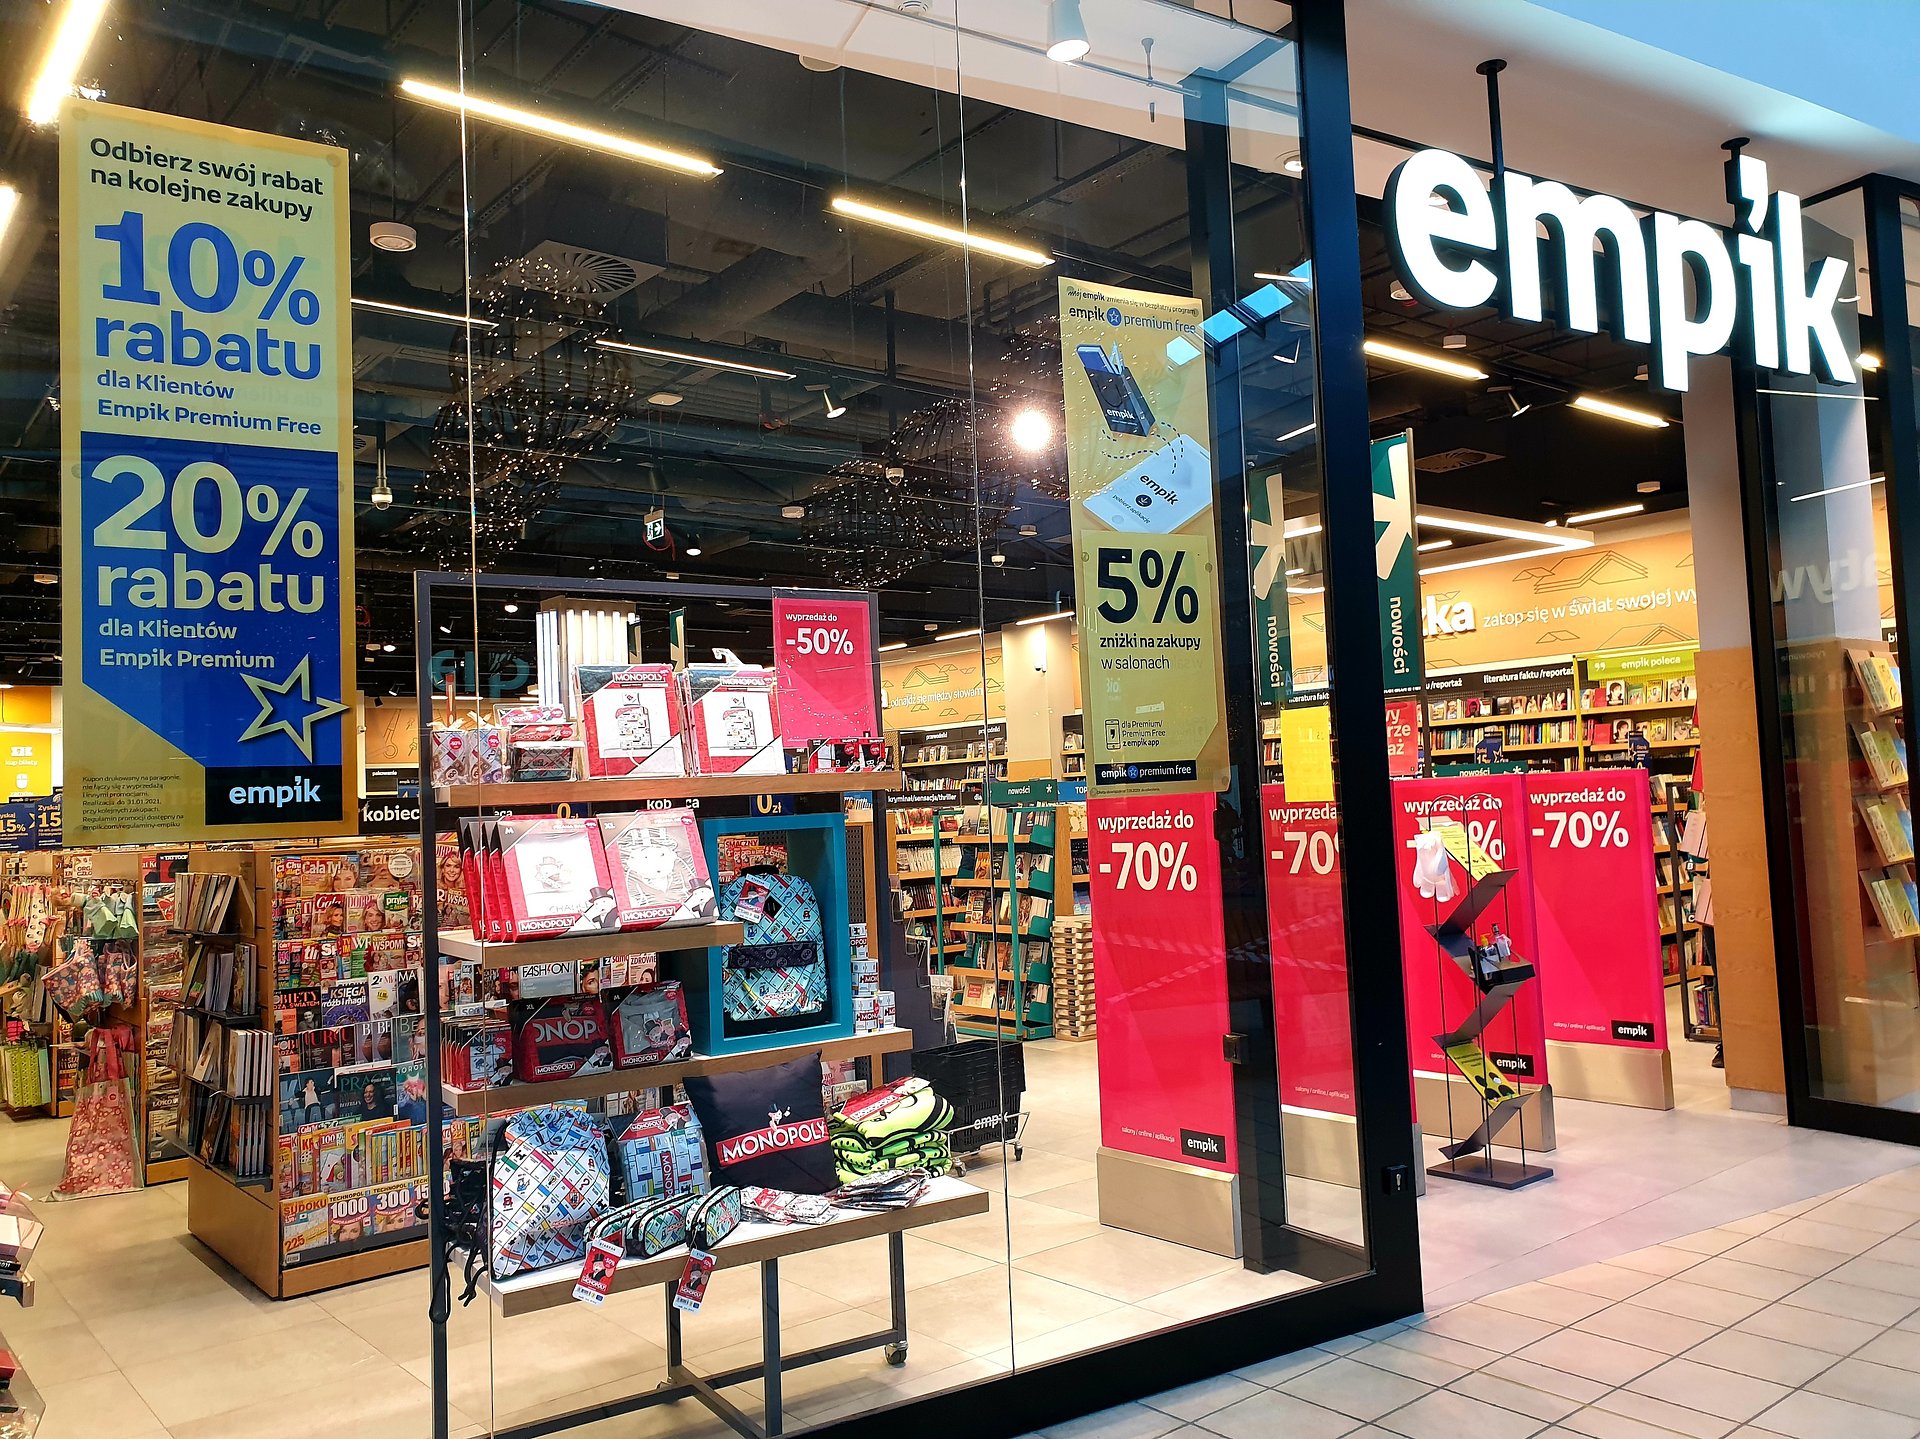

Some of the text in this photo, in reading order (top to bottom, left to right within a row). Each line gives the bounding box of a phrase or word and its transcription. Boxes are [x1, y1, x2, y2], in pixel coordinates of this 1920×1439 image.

[90, 137, 324, 196] Odbierz swój rabat
[90, 167, 313, 222] na kolejne zakupy
[94, 210, 321, 326] 10%
[1386, 147, 1857, 393] empik
[1069, 305, 1197, 334] empik premium free
[95, 310, 322, 380] rabatu
[96, 369, 236, 400] dla Klientów
[98, 398, 322, 435] Empik Premium Free
[1106, 408, 1136, 420] empik
[1139, 474, 1180, 506] empik
[91, 454, 324, 558] 20%
[97, 553, 324, 614] rabatu
[1097, 547, 1200, 624] 5%
[785, 612, 838, 622] wyprzedaż do
[1483, 610, 1524, 628] zatop
[1526, 607, 1549, 623] się
[1552, 607, 1566, 618] w
[1569, 598, 1613, 617] świat
[1616, 592, 1672, 612] swojej
[99, 618, 238, 641] dla Klientów
[1389, 596, 1410, 675] nowości
[785, 628, 854, 655] -50%
[1099, 633, 1201, 650] zniżki na zakupy
[99, 648, 276, 670] Empik Premium
[1267, 615, 1284, 688] nowości
[1101, 655, 1170, 669] w salonach
[1621, 656, 1681, 669] empik poleca
[612, 672, 664, 682] MONOPOLY
[1483, 673, 1518, 684] literatura
[1518, 670, 1539, 680] faktu
[1121, 721, 1131, 729] dla
[1122, 729, 1166, 737] Premium Free
[1126, 738, 1147, 748] empik
[1101, 765, 1192, 780] empik premium free
[93, 783, 111, 791] łączy
[126, 782, 164, 790] wyprzedażą
[229, 775, 321, 808] empik
[1007, 785, 1031, 795] nowości
[1529, 786, 1626, 806] wyprzedaż do
[772, 803, 782, 814] zł
[1268, 803, 1338, 824] wyprzeda
[1403, 795, 1502, 816] wyprzedaż do
[117, 814, 147, 822] promocji
[146, 814, 176, 822] dostępny
[1097, 810, 1194, 834] wyprzedaż do
[1532, 810, 1630, 850] -70%
[1099, 840, 1198, 892] -70%
[623, 908, 675, 921] MONOPOLY
[520, 918, 574, 931] MONOPOLY
[330, 987, 366, 1000] KSIĘGA
[345, 994, 367, 1006] magii
[1617, 1023, 1648, 1037] empik
[536, 1062, 575, 1075] MONOPOLY
[623, 1053, 659, 1066] MONOPOLY
[1496, 1058, 1527, 1070] empik
[722, 1121, 828, 1162] MONOPOLY
[1187, 1137, 1219, 1153] empik
[329, 1190, 365, 1203] TECHNOPOL
[373, 1183, 408, 1195] TECHNOPOL
[283, 1198, 328, 1216] SUDOKU
[329, 1197, 369, 1220] 1000
[376, 1190, 411, 1211] 300
[284, 1234, 306, 1253] 225
